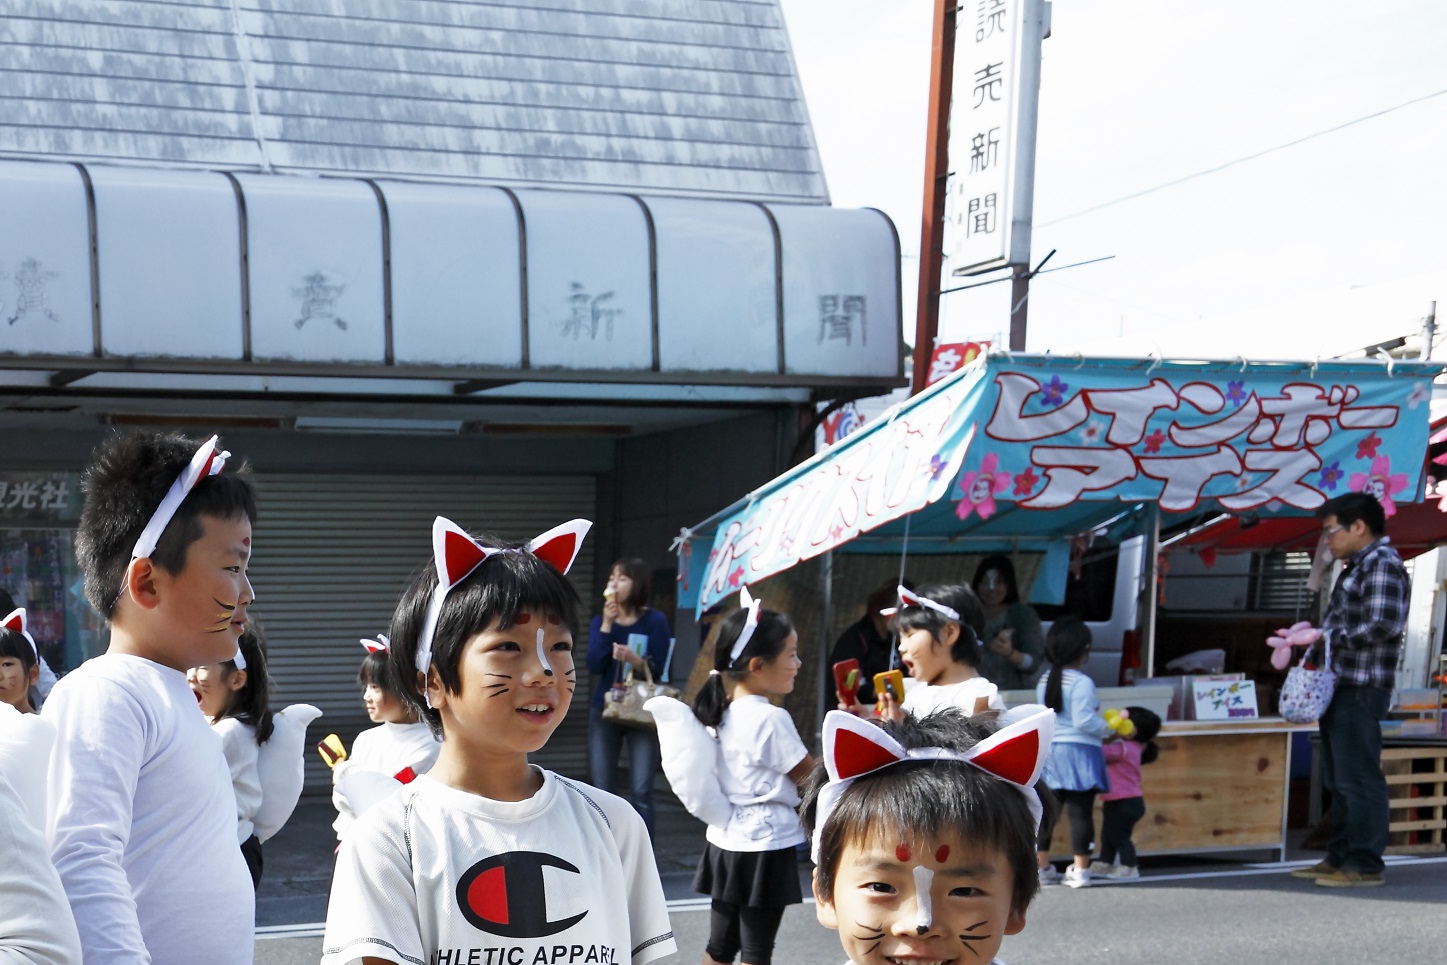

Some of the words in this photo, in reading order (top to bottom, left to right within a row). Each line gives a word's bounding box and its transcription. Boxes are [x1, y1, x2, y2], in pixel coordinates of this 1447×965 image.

[967, 0, 1006, 239] 読売新聞
[985, 371, 1400, 449] レインボー
[1017, 442, 1328, 512] アイス
